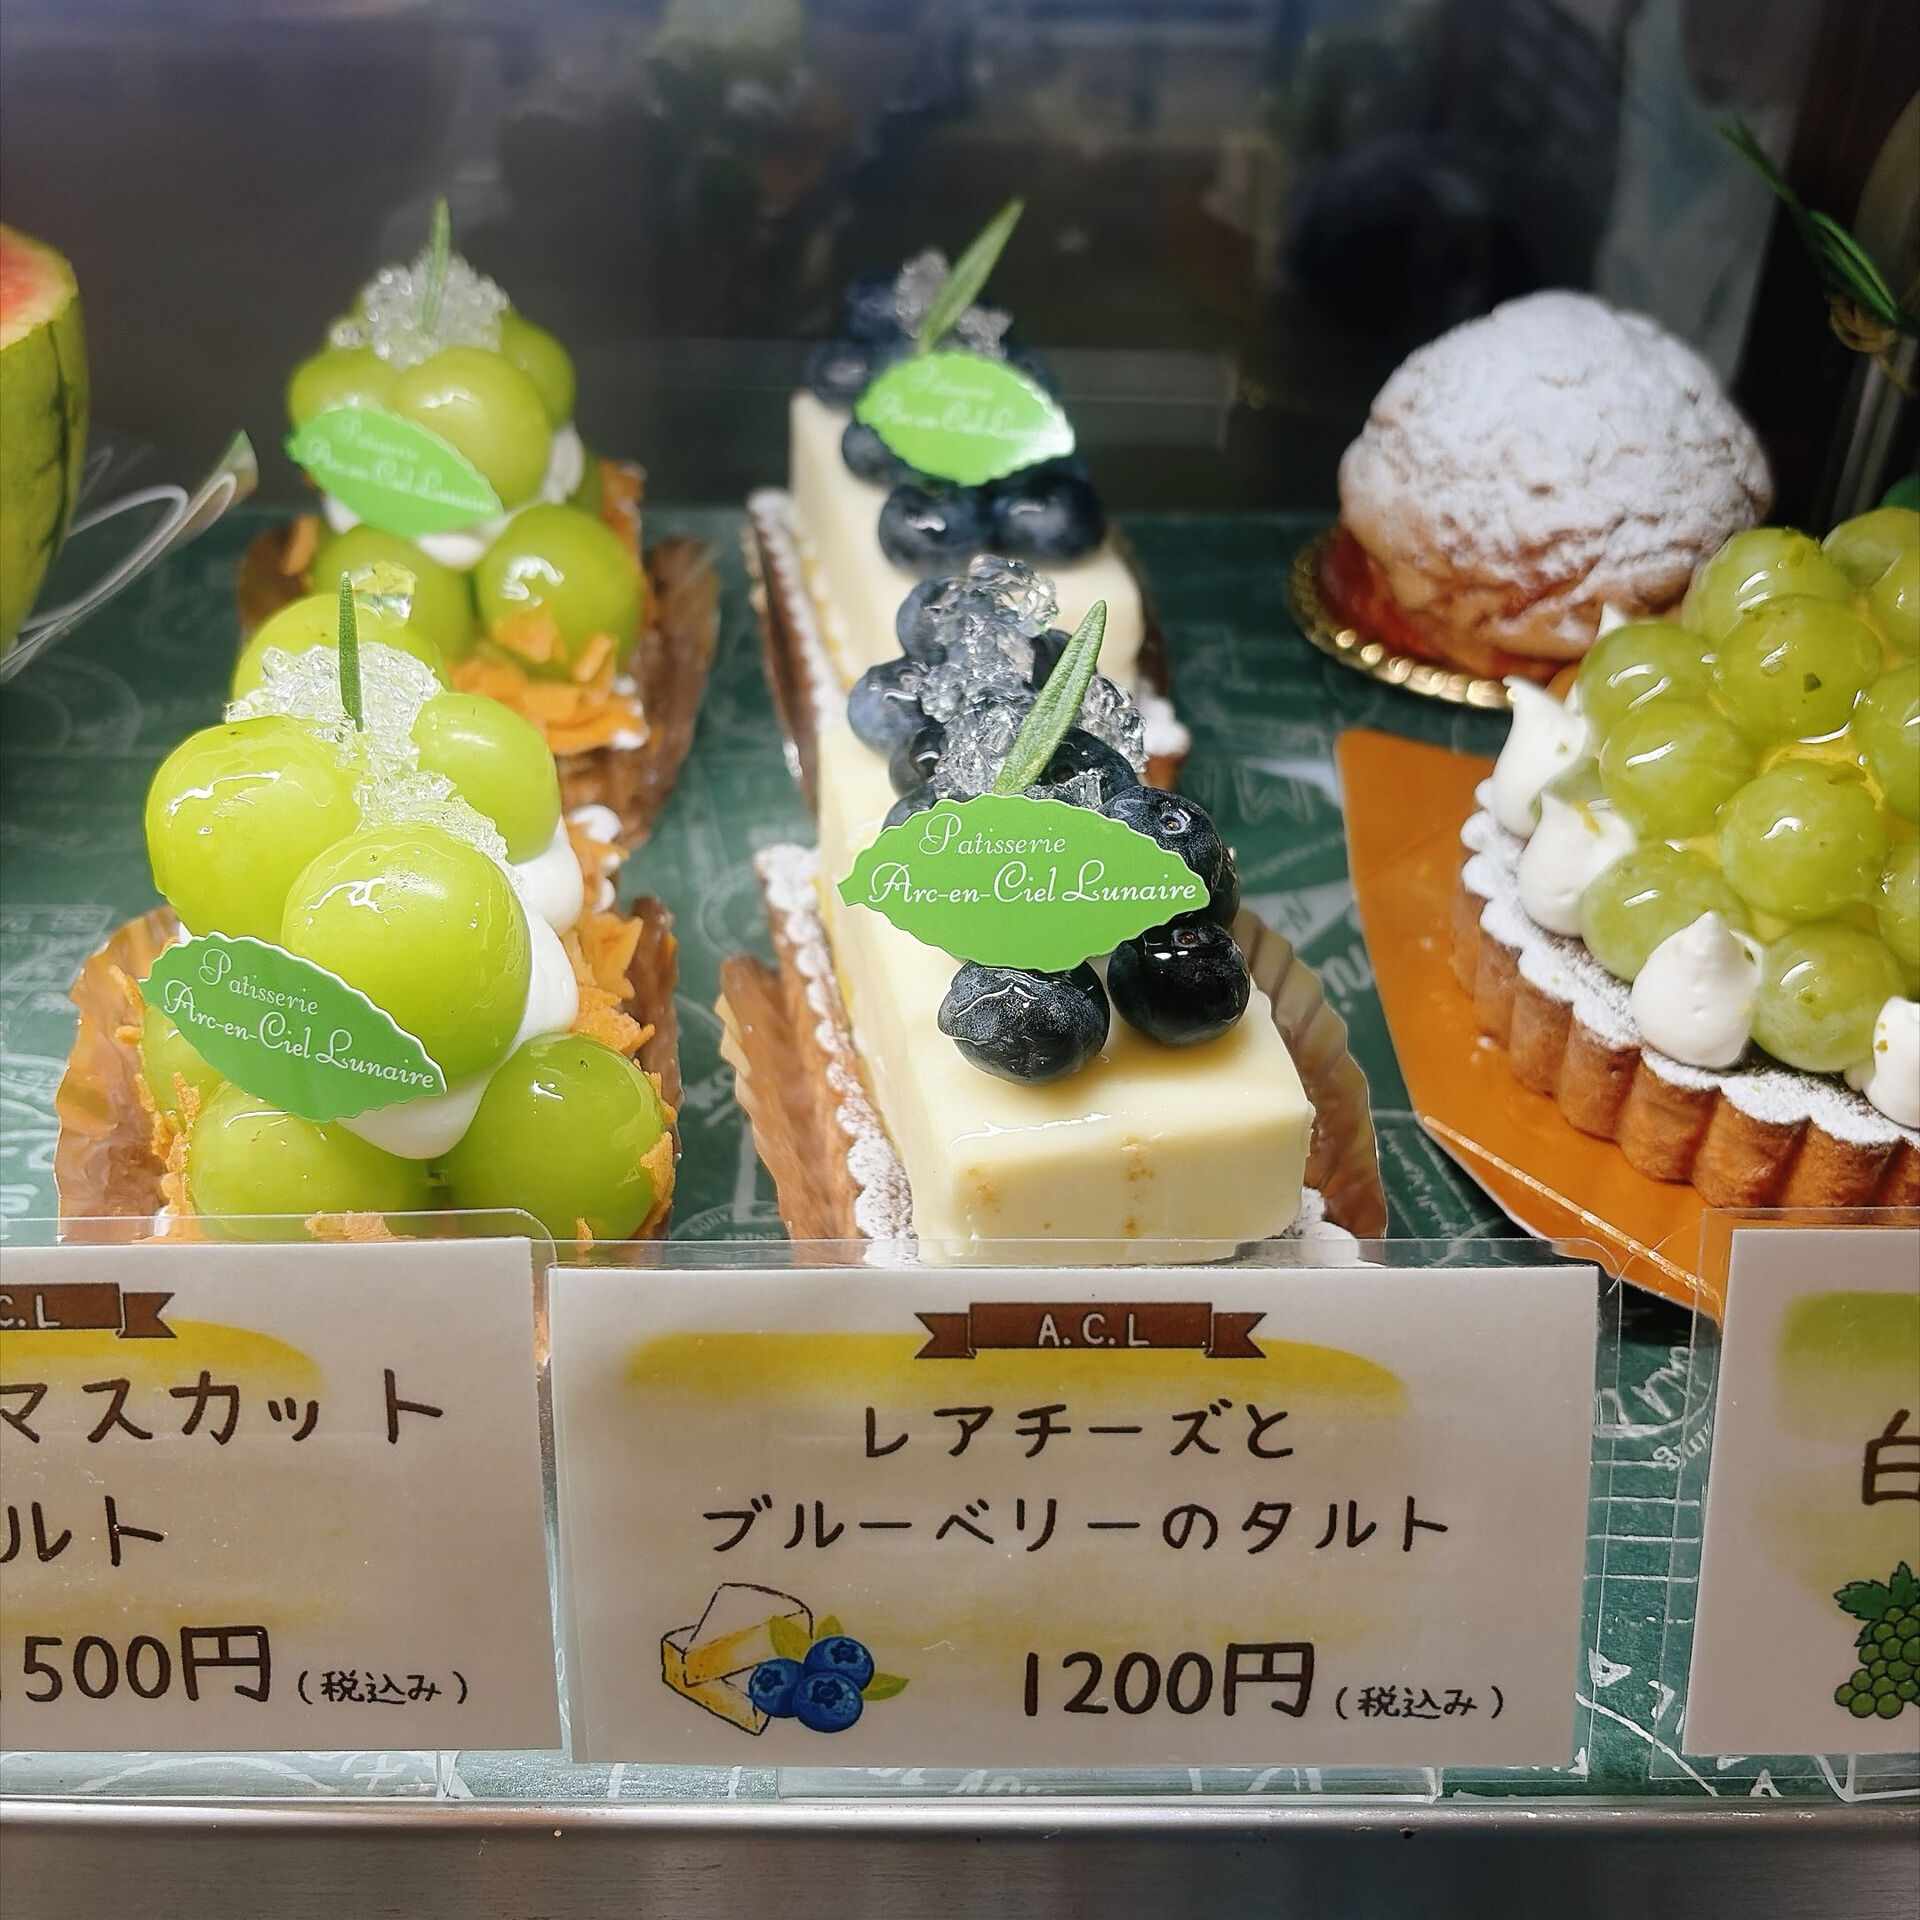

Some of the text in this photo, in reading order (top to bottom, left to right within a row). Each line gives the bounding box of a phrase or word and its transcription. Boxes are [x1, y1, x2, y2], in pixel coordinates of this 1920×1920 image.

[917, 812, 1067, 856] Patisserie
[867, 860, 1057, 905] Arc-en-Ciel
[1062, 858, 1197, 904] Lunaire
[197, 947, 320, 1016] Patisserie
[163, 979, 435, 1090] Arc-en-Ciel Lunaire
[1037, 1312, 1151, 1348] A.C.L
[864, 1398, 1295, 1460] レアチーズと
[1861, 1408, 1920, 1506] 白
[0, 1495, 166, 1568] ルト
[702, 1493, 1449, 1555] ブルーベリーのタルト
[0, 1624, 272, 1703] 500円
[1022, 1641, 1316, 1718] 1200円
